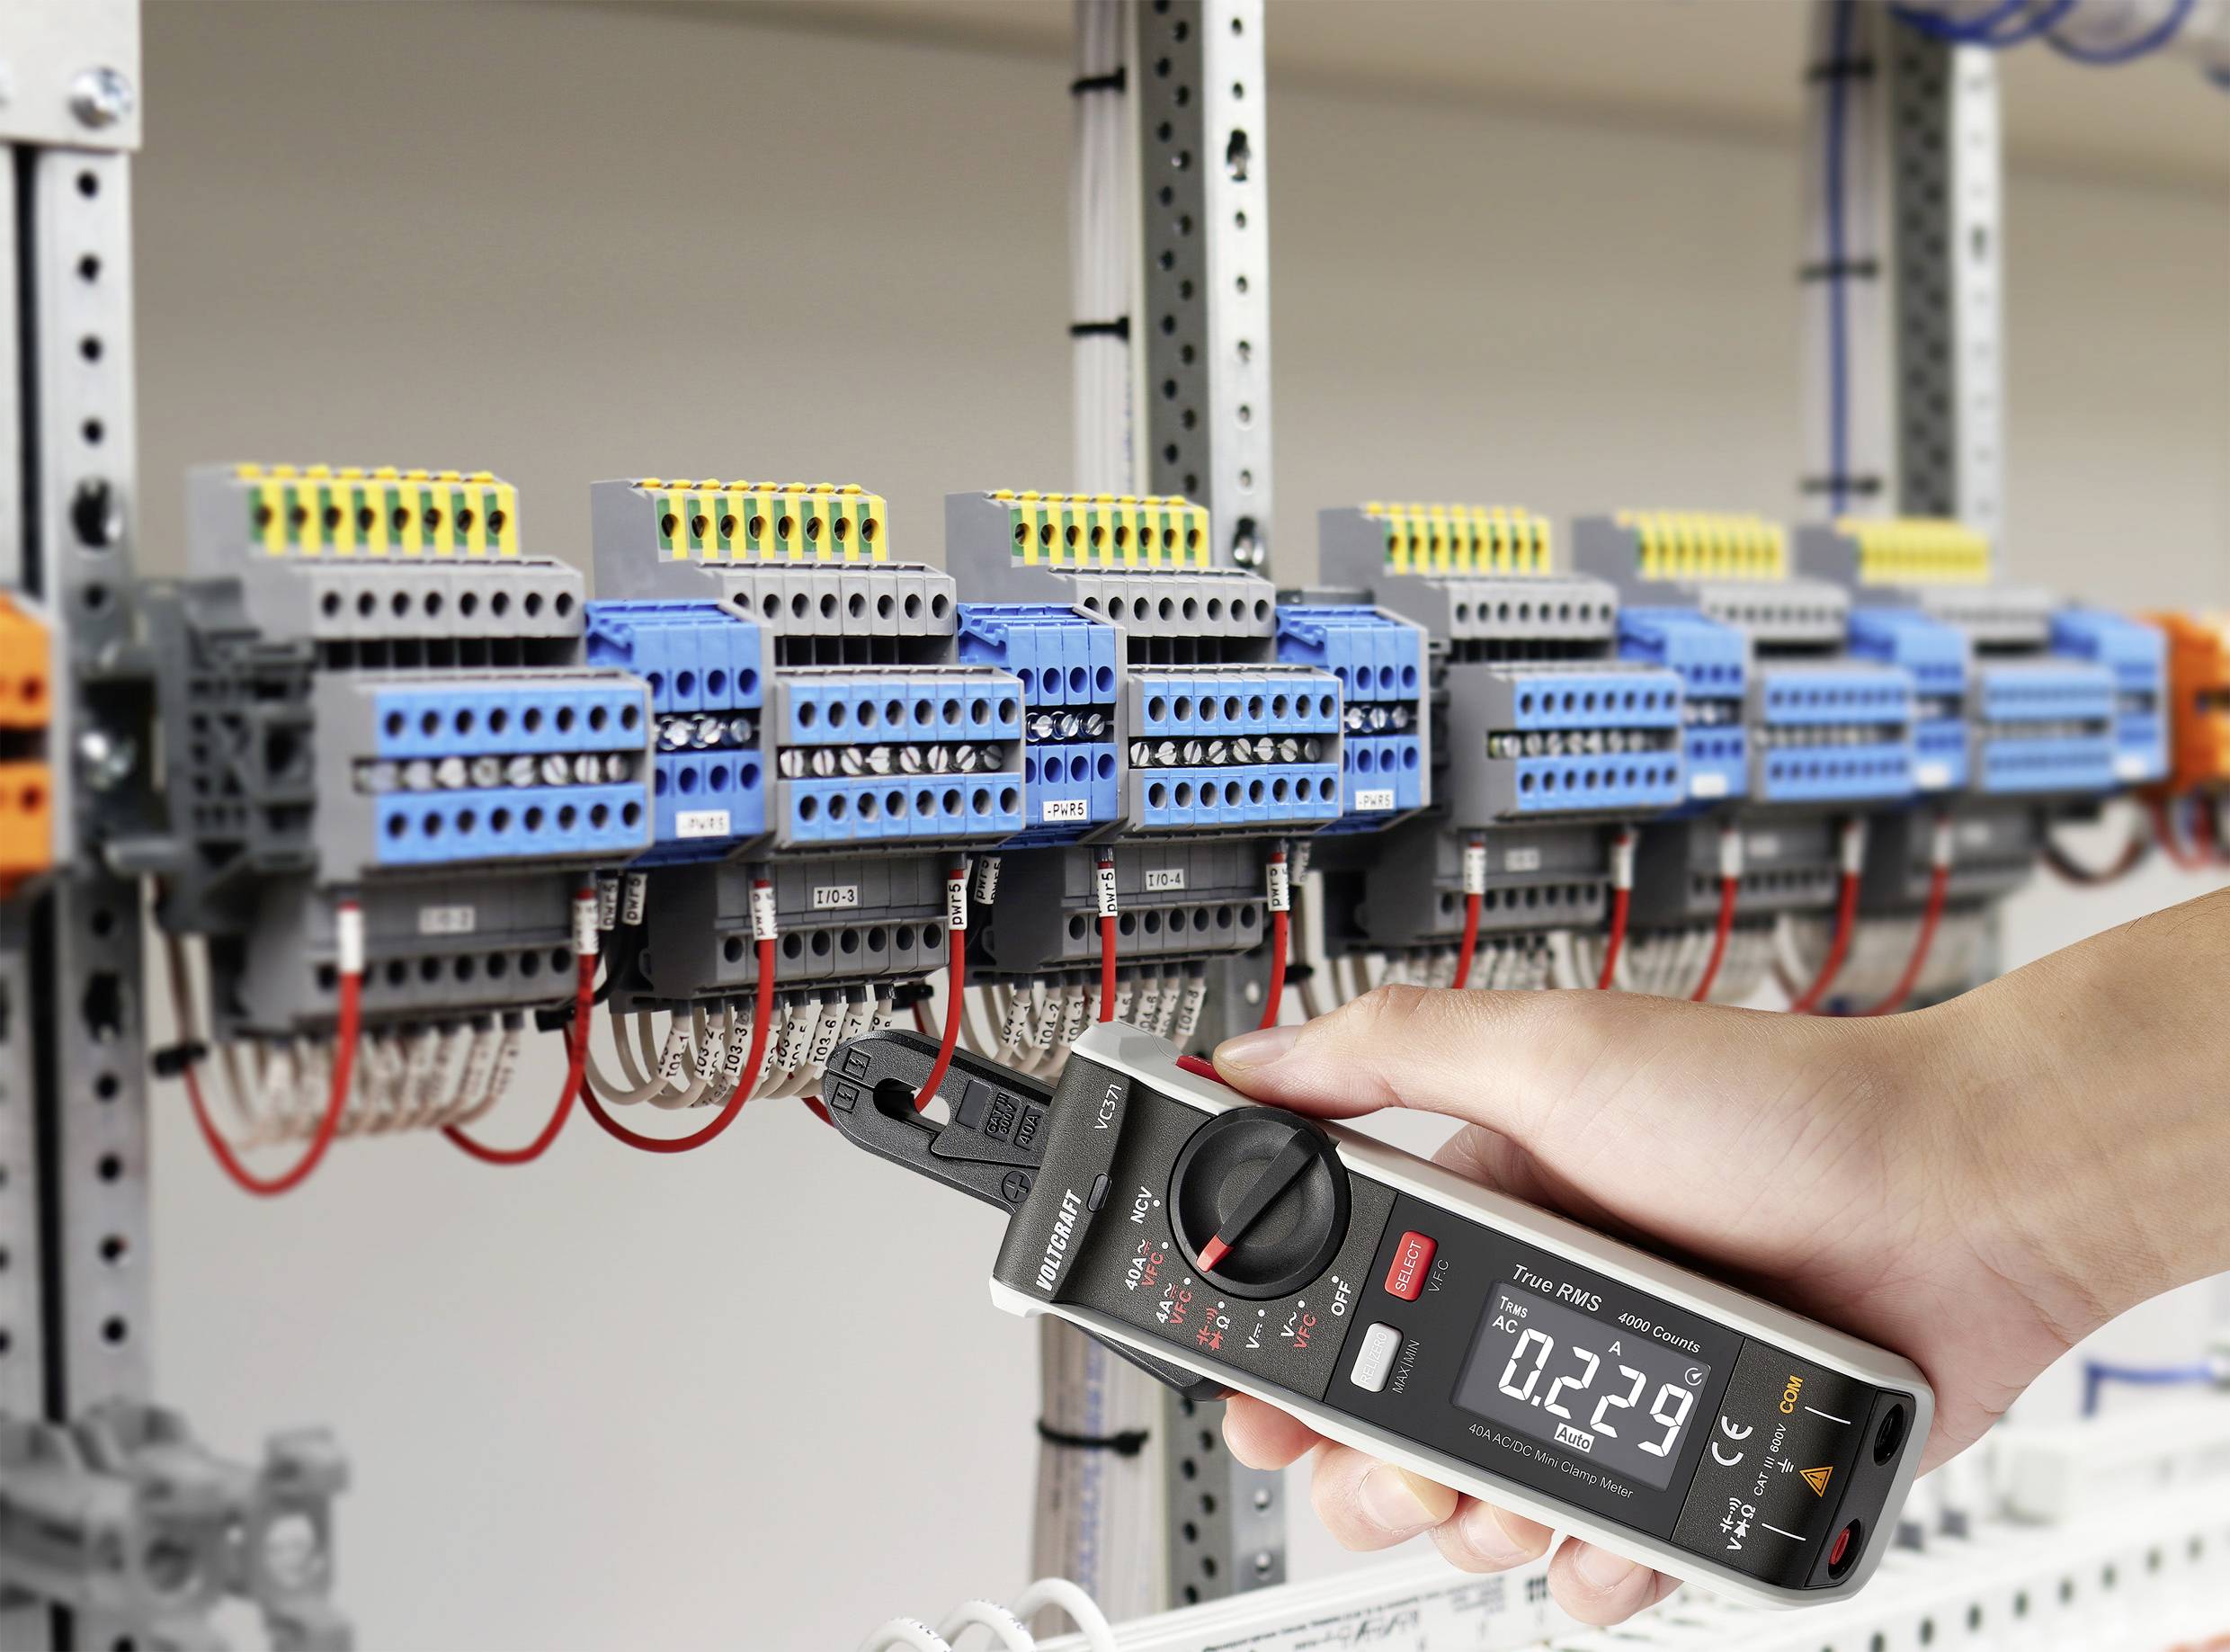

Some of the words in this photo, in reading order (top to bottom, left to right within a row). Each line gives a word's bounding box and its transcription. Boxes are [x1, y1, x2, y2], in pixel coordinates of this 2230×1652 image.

[1047, 802, 1084, 817] -PWR5
[816, 889, 855, 905] I/O-3
[1102, 871, 1117, 913] pwr5
[1148, 872, 1182, 888] I/O-4
[949, 883, 964, 926] pwr5
[1093, 1084, 1122, 1130] VC371
[1019, 1114, 1041, 1145] 40A
[1129, 1185, 1153, 1225] NCV
[1035, 1188, 1082, 1291] VOLTCRAFT
[1140, 1251, 1164, 1288] VFC
[1395, 1239, 1423, 1292] SELECT
[1428, 1259, 1450, 1292] V.F.C
[1331, 1280, 1351, 1317] OFF
[1512, 1264, 1554, 1293] True
[1556, 1281, 1603, 1313] RMS
[1169, 1290, 1193, 1325] VFC
[1492, 1315, 1519, 1335] AC
[1293, 1313, 1317, 1349] VFC
[1608, 1340, 1623, 1357] A
[1617, 1310, 1651, 1334] 4000
[1652, 1325, 1702, 1354] Counts
[1498, 1328, 1694, 1459] 0.229
[1779, 1374, 1805, 1415] COM
[1557, 1426, 1591, 1450] Auto
[1711, 1415, 1753, 1467] CE
[1769, 1423, 1788, 1453] 600V
[1468, 1423, 1492, 1442] 40A
[1492, 1433, 1533, 1457] AC/DC
[1534, 1449, 1559, 1469] Mini
[1560, 1460, 1598, 1486] Clamp
[1599, 1476, 1635, 1500] Meter
[1763, 1456, 1776, 1469] III
[1753, 1471, 1770, 1496] CAT
